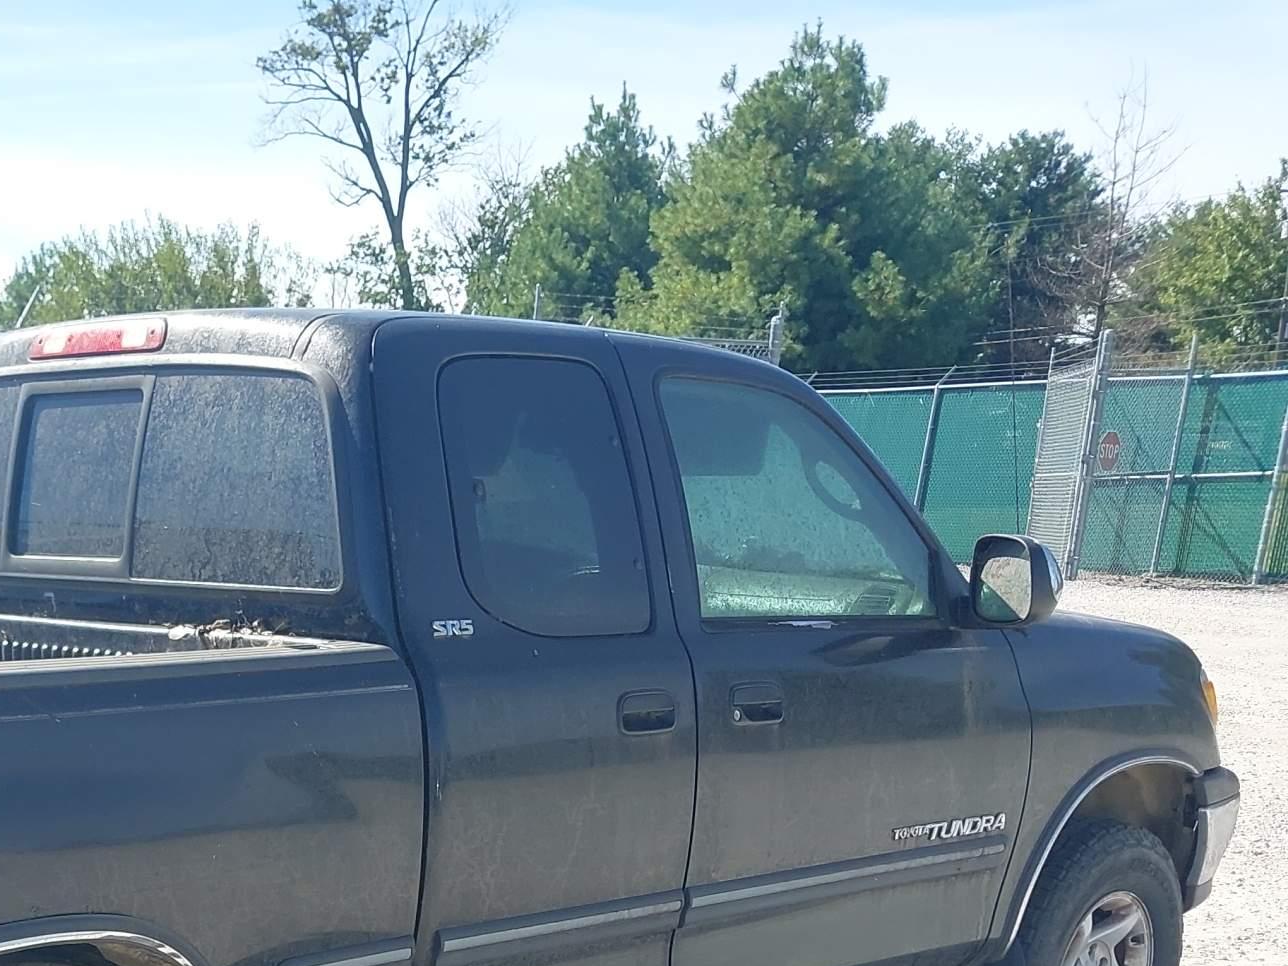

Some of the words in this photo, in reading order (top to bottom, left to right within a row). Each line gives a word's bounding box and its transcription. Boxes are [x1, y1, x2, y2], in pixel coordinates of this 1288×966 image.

[1100, 443, 1120, 459] STOP
[432, 619, 474, 637] SR5
[893, 824, 930, 841] TOYOTA
[929, 813, 1006, 841] TUNDRA
